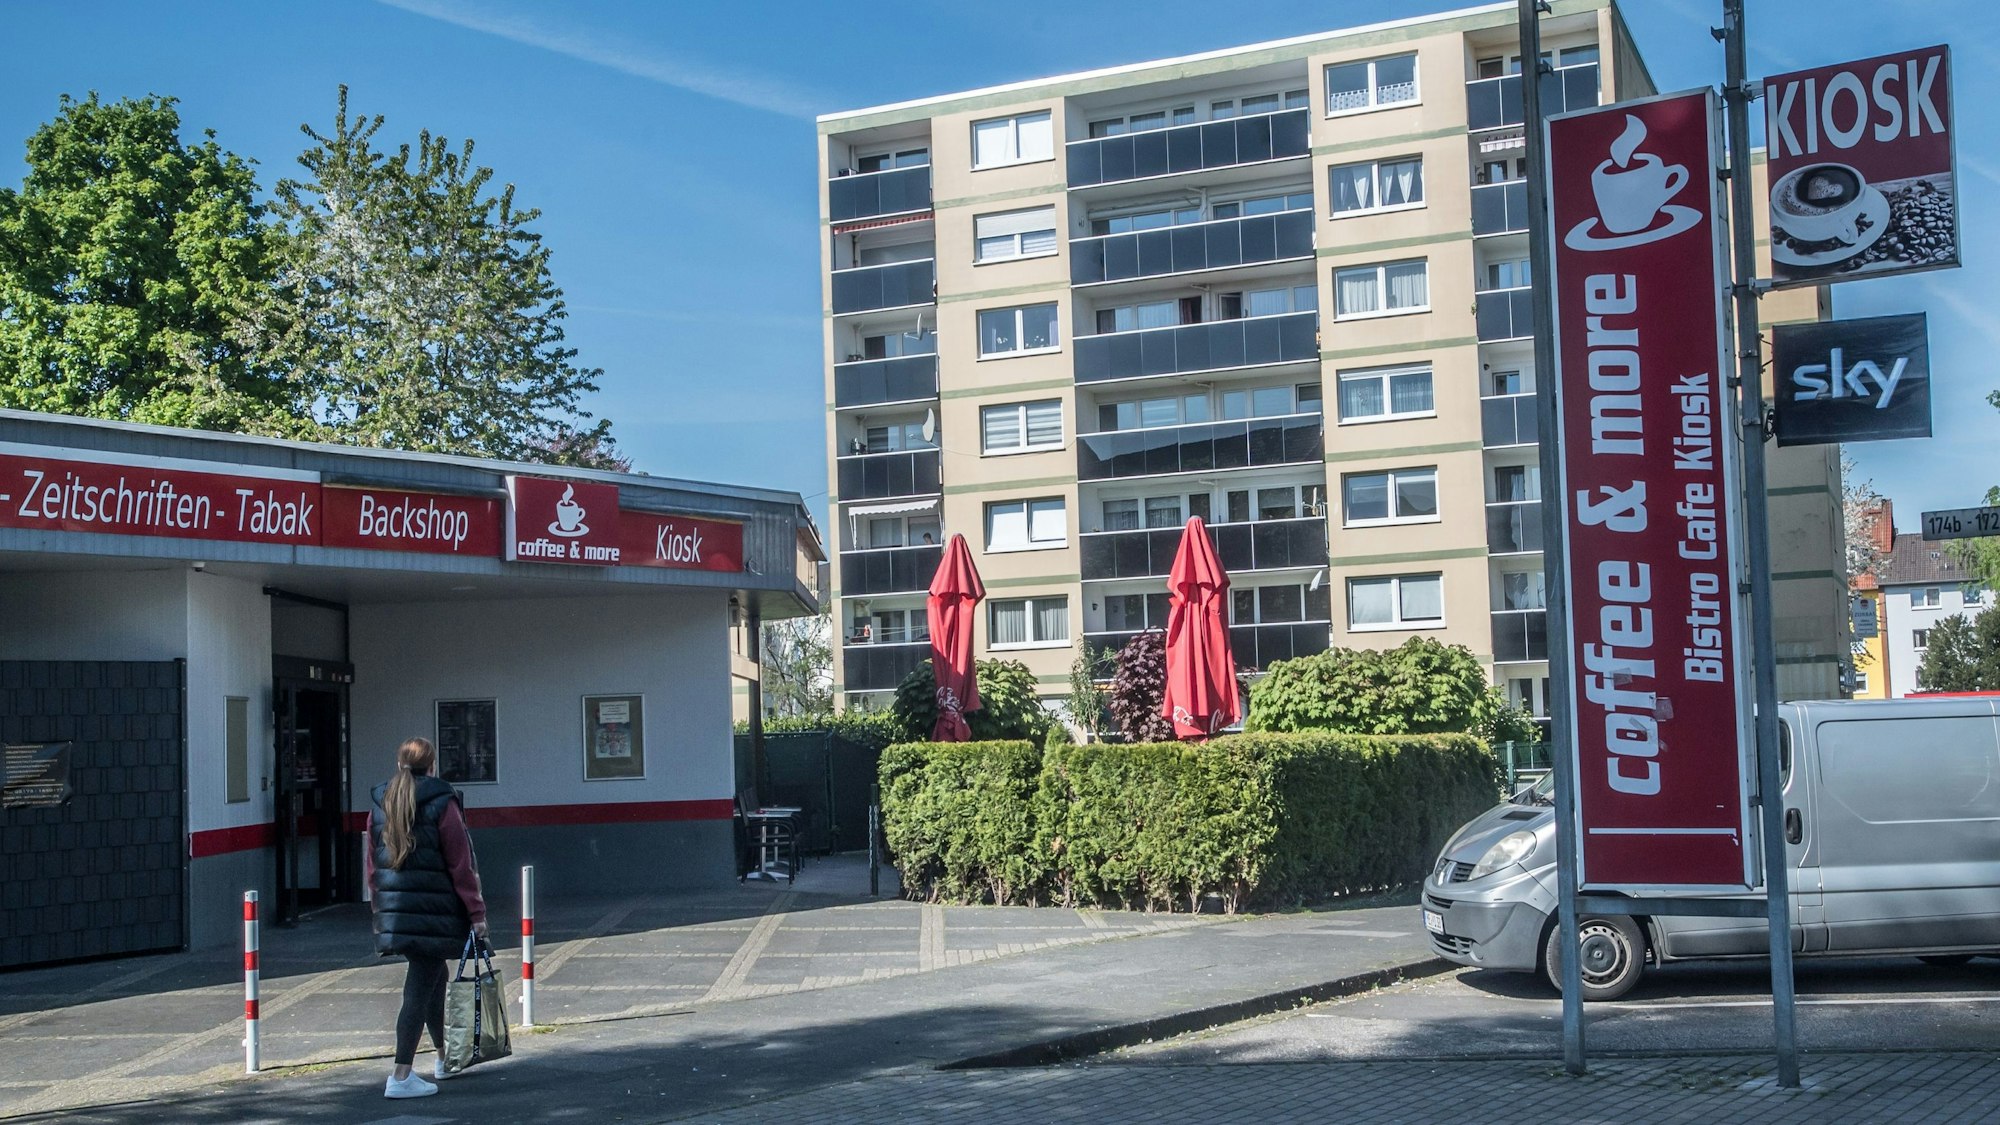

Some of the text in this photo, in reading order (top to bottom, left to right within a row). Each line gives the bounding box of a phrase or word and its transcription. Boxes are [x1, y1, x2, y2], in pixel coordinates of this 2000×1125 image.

[1766, 55, 1946, 160] KIOSK
[1793, 347, 1908, 409] sky
[18, 469, 211, 530] Zeitschriften
[235, 488, 314, 537] Tabak
[358, 495, 469, 551] Backshop
[1671, 373, 1724, 683] Bistro Cafe Kiosk
[1928, 515, 1962, 535] 174b
[1975, 512, 2000, 531] 172
[518, 539, 620, 562] coffee & more
[656, 524, 703, 563] Kiosk
[1577, 273, 1661, 796] coffee & more
